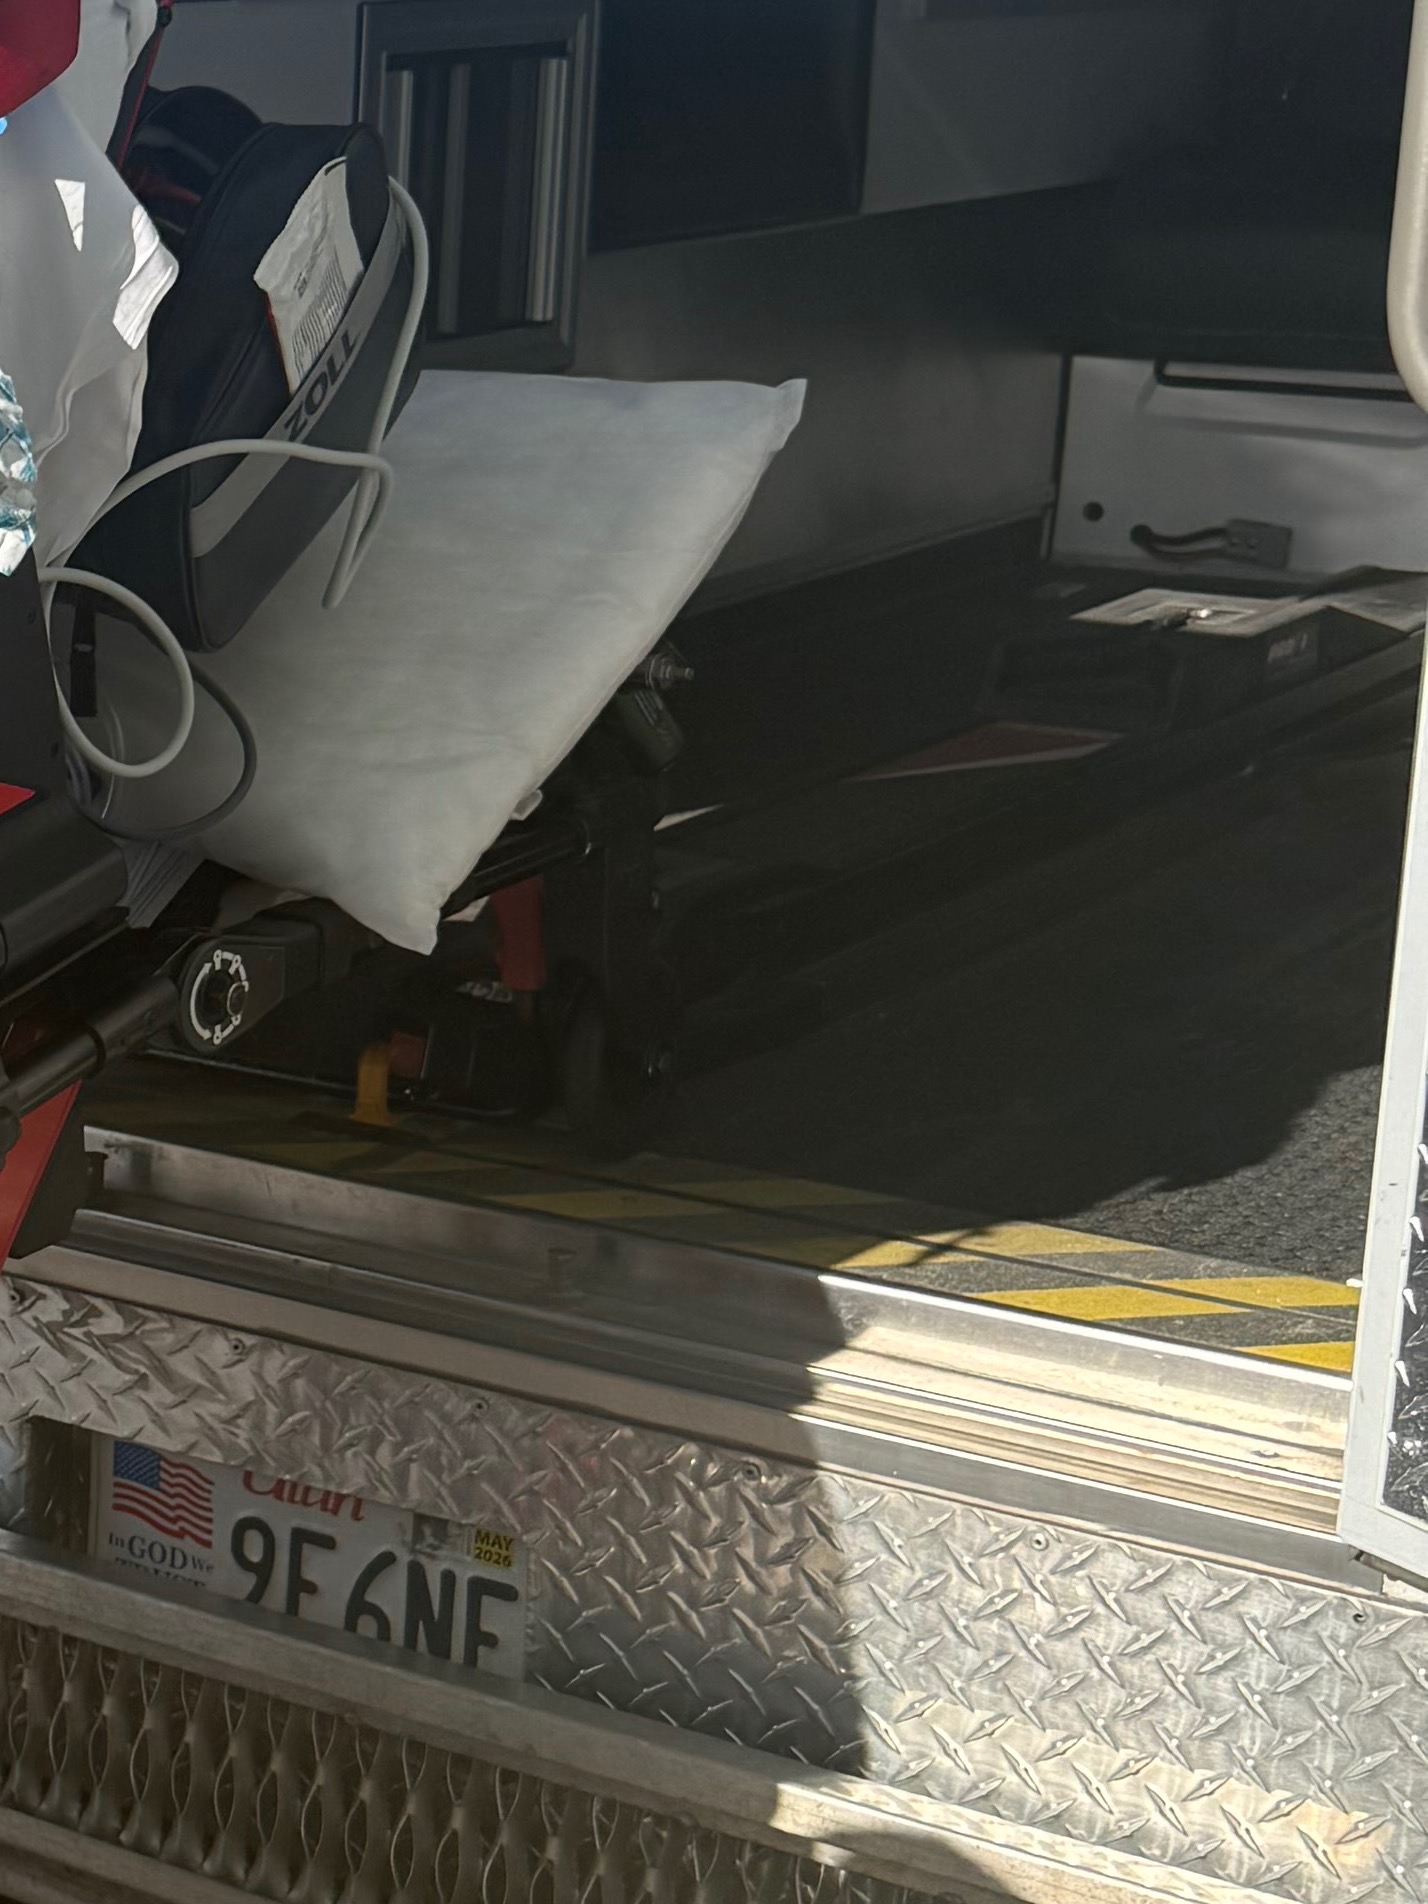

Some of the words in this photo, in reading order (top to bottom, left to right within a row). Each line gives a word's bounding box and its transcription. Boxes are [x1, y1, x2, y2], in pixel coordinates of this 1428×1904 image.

[283, 328, 362, 443] ZOLL
[108, 1532, 126, 1550] In
[127, 1534, 189, 1571] GOD
[191, 1554, 216, 1573] We
[473, 1528, 514, 1553] MAY
[473, 1547, 514, 1568] 2026
